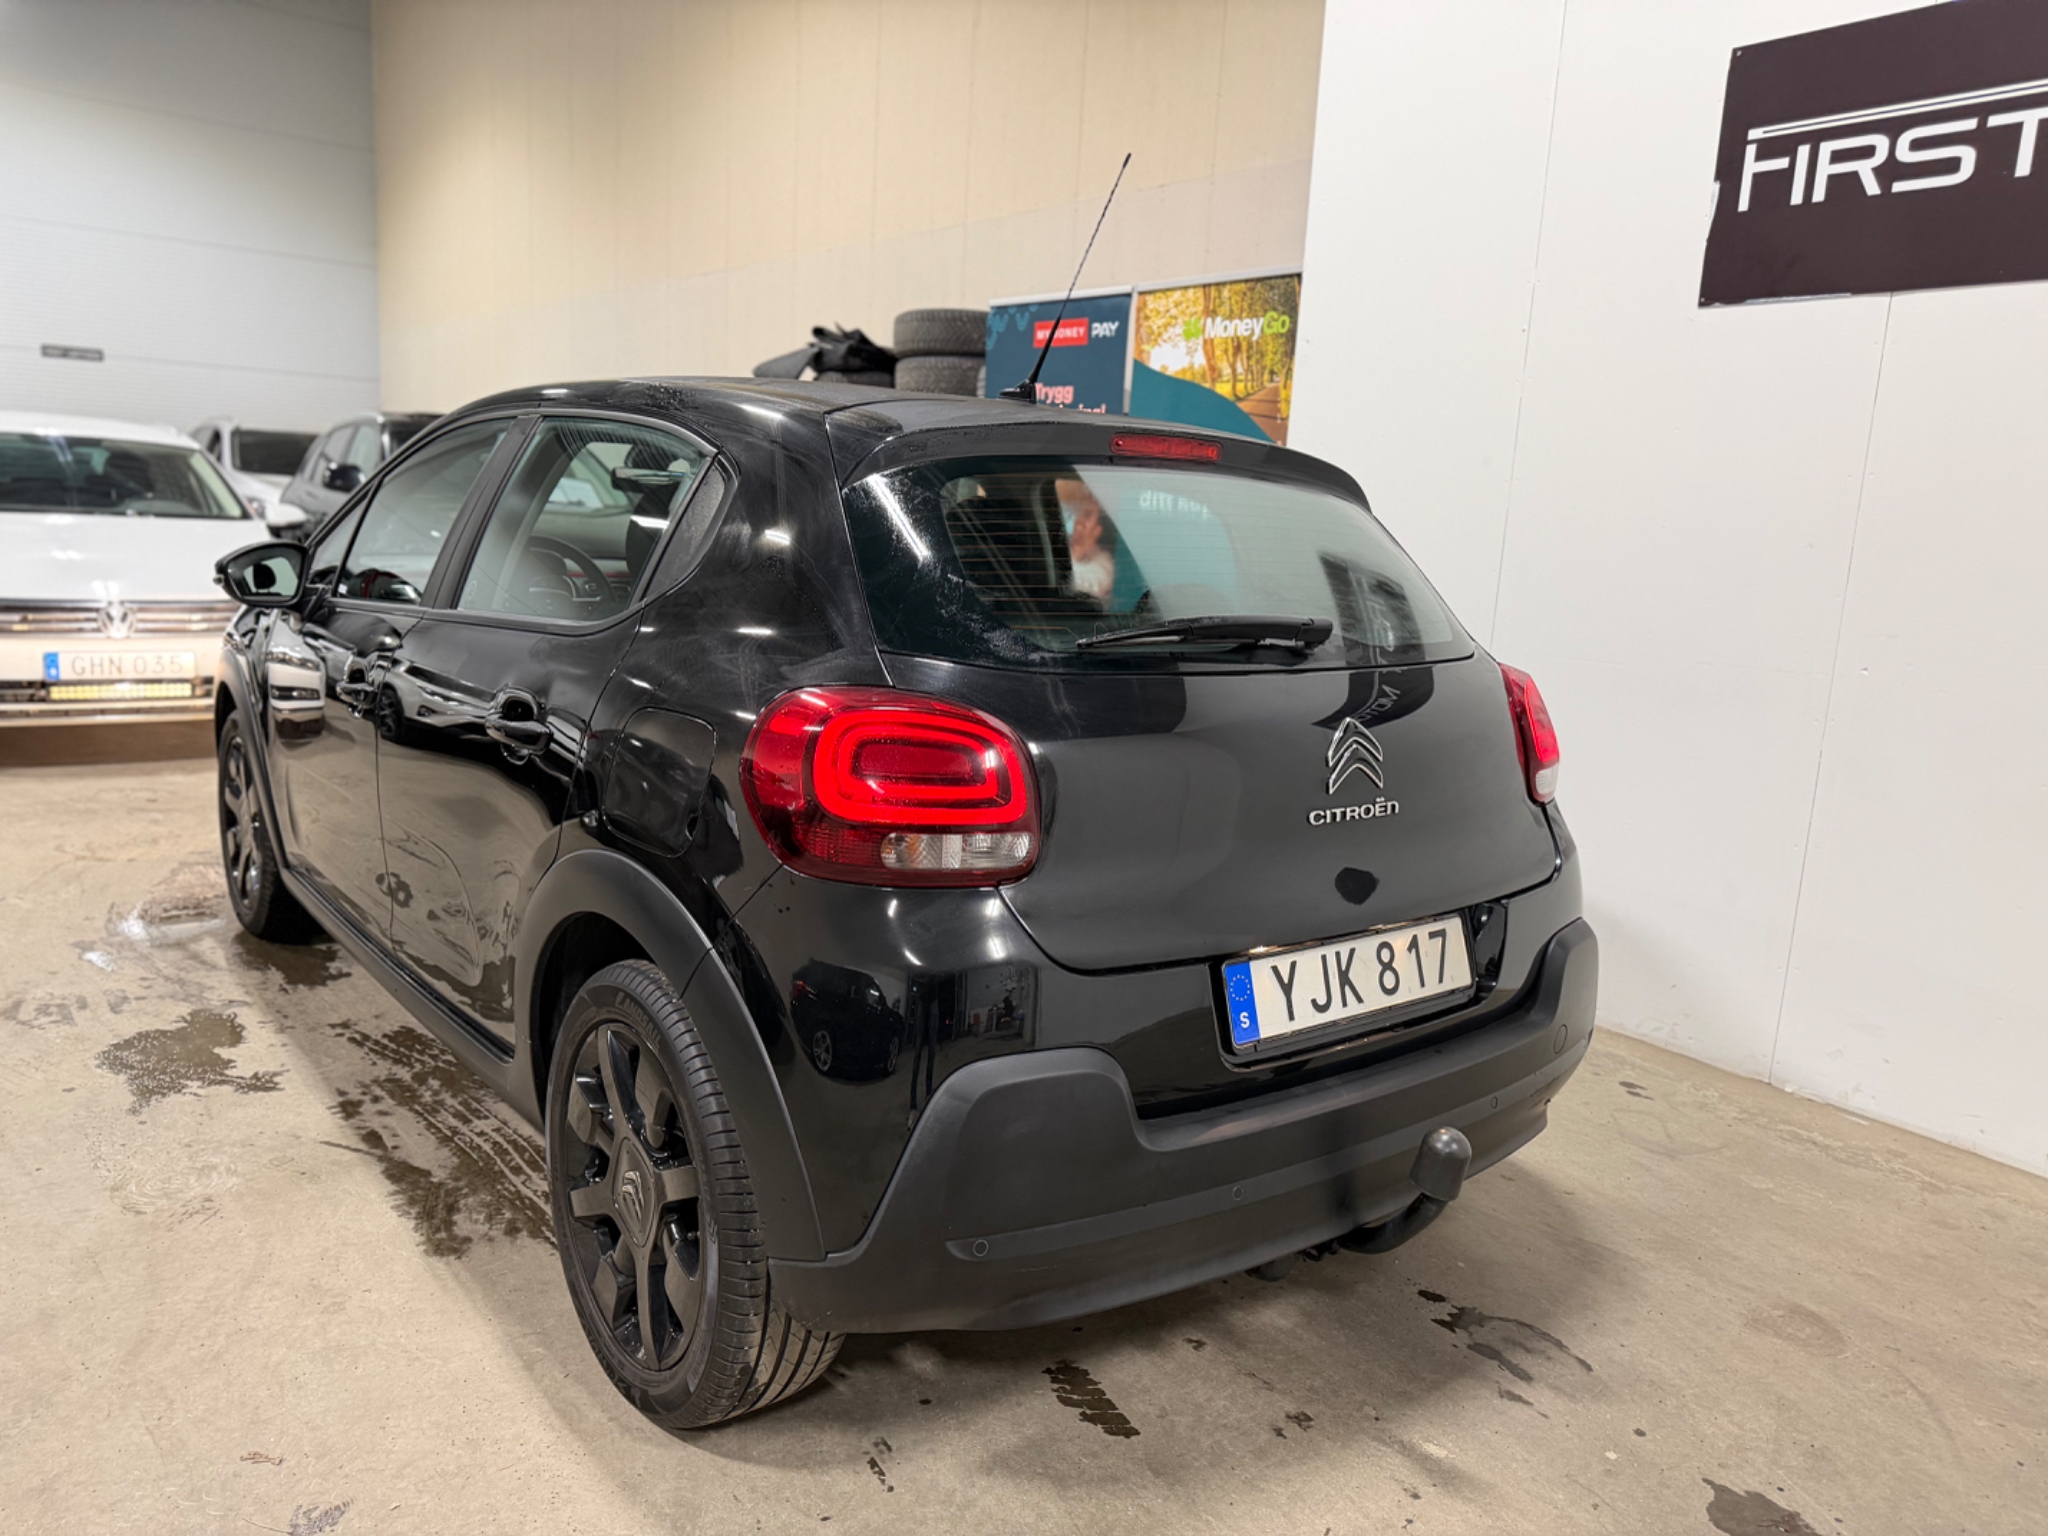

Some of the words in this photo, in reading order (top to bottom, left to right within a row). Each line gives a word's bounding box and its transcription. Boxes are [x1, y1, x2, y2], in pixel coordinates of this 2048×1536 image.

[1737, 104, 2048, 213] FIRST
[1091, 320, 1120, 339] PAY
[1204, 311, 1291, 341] MoneyGo
[1034, 382, 1075, 405] Trygg
[71, 655, 123, 677] GHN
[133, 655, 184, 676] 035
[1270, 946, 1365, 1022] YJK
[1375, 927, 1448, 996] 817
[1239, 1012, 1250, 1029] S
